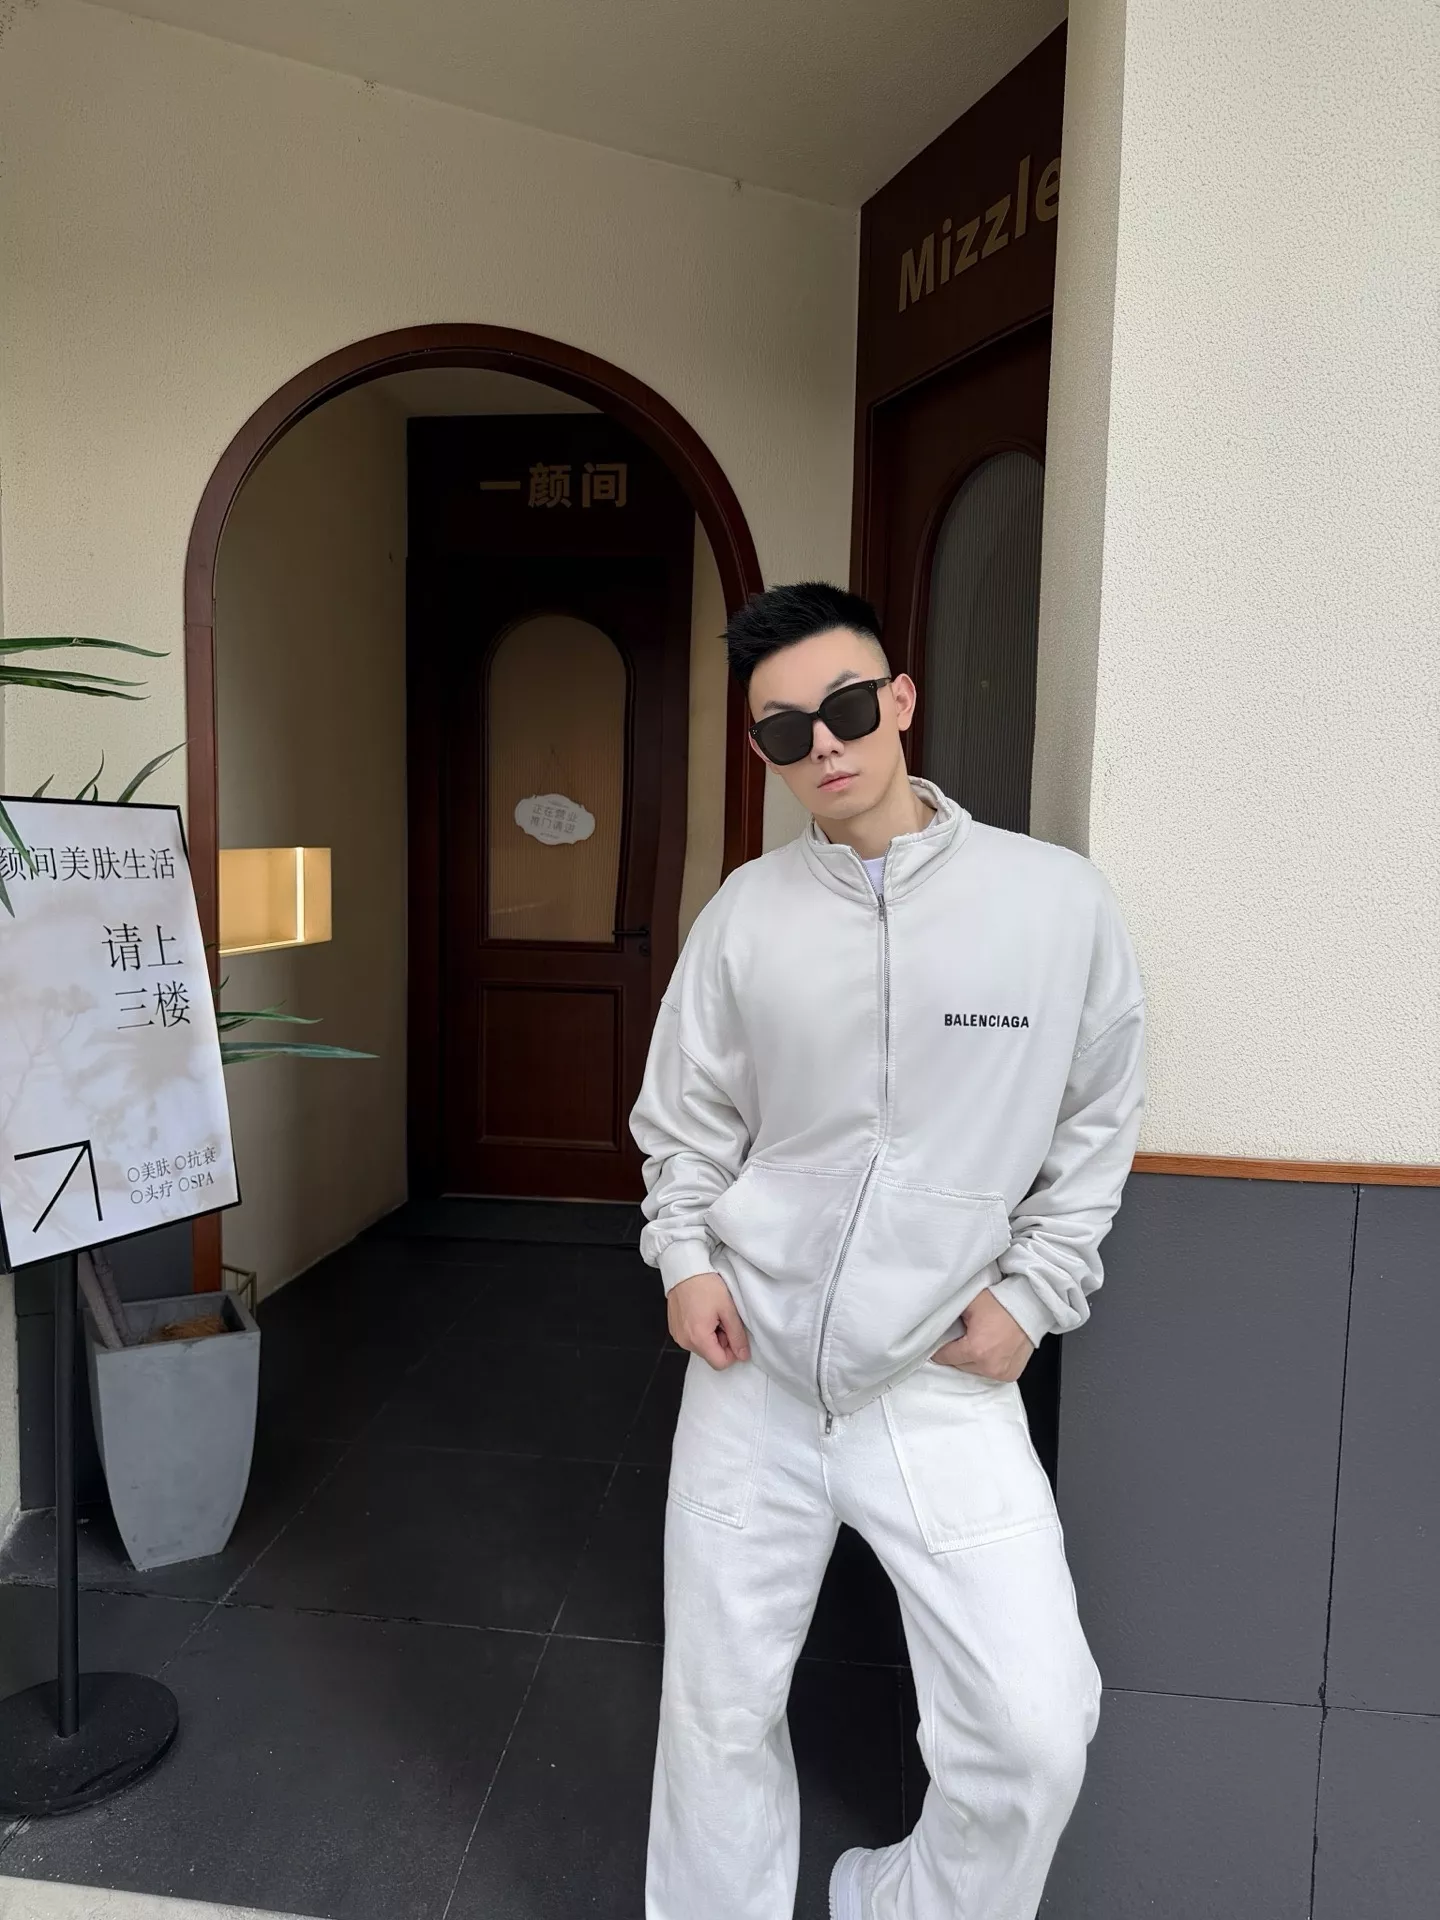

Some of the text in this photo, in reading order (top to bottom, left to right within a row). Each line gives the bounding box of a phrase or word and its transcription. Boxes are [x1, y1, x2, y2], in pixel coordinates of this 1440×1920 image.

[899, 154, 1061, 313] Mizzle
[479, 462, 628, 508] 一颜间
[101, 923, 184, 971] 请上
[115, 980, 191, 1030] 三楼
[944, 1013, 1029, 1028] BALENCIAGA
